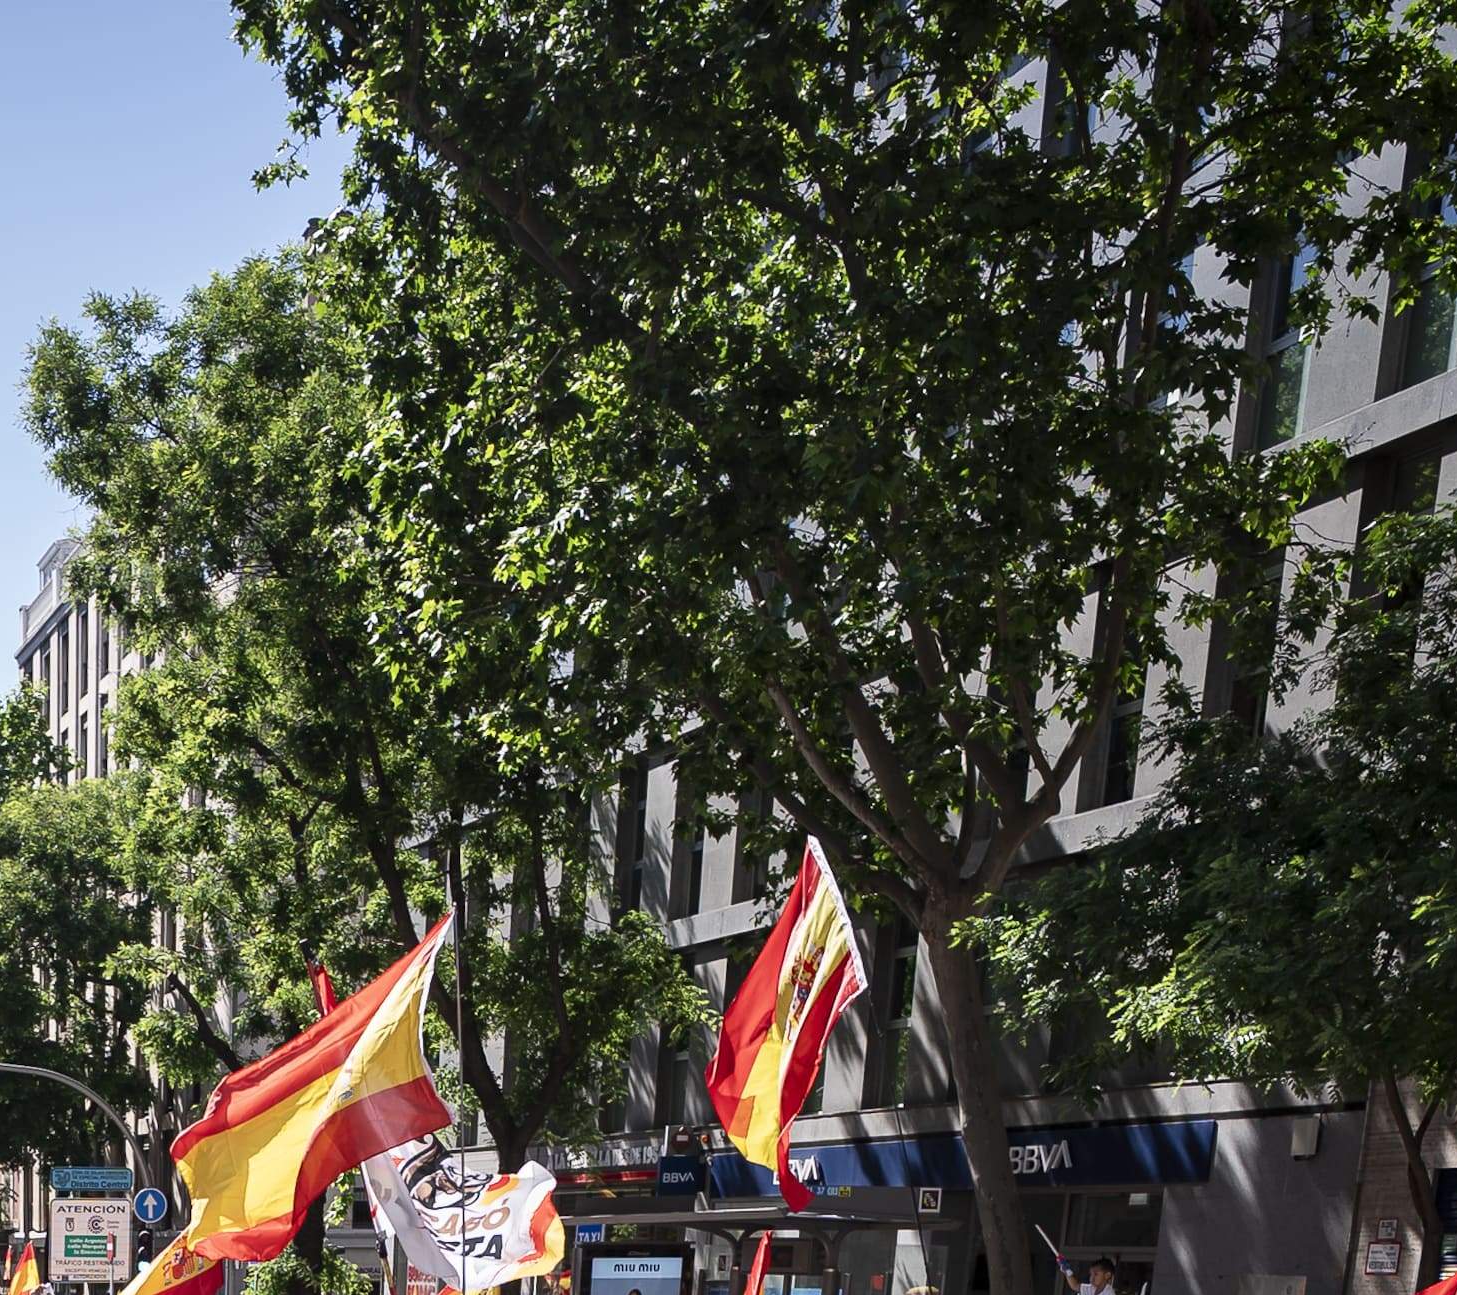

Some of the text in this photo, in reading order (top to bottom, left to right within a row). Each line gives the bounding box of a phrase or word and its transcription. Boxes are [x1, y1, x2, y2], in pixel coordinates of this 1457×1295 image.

[1009, 1140, 1073, 1174] BBVA
[662, 1172, 695, 1183] BBVA
[71, 1180, 129, 1189] Distrito Centro
[56, 1204, 126, 1214] ATENCIÓN
